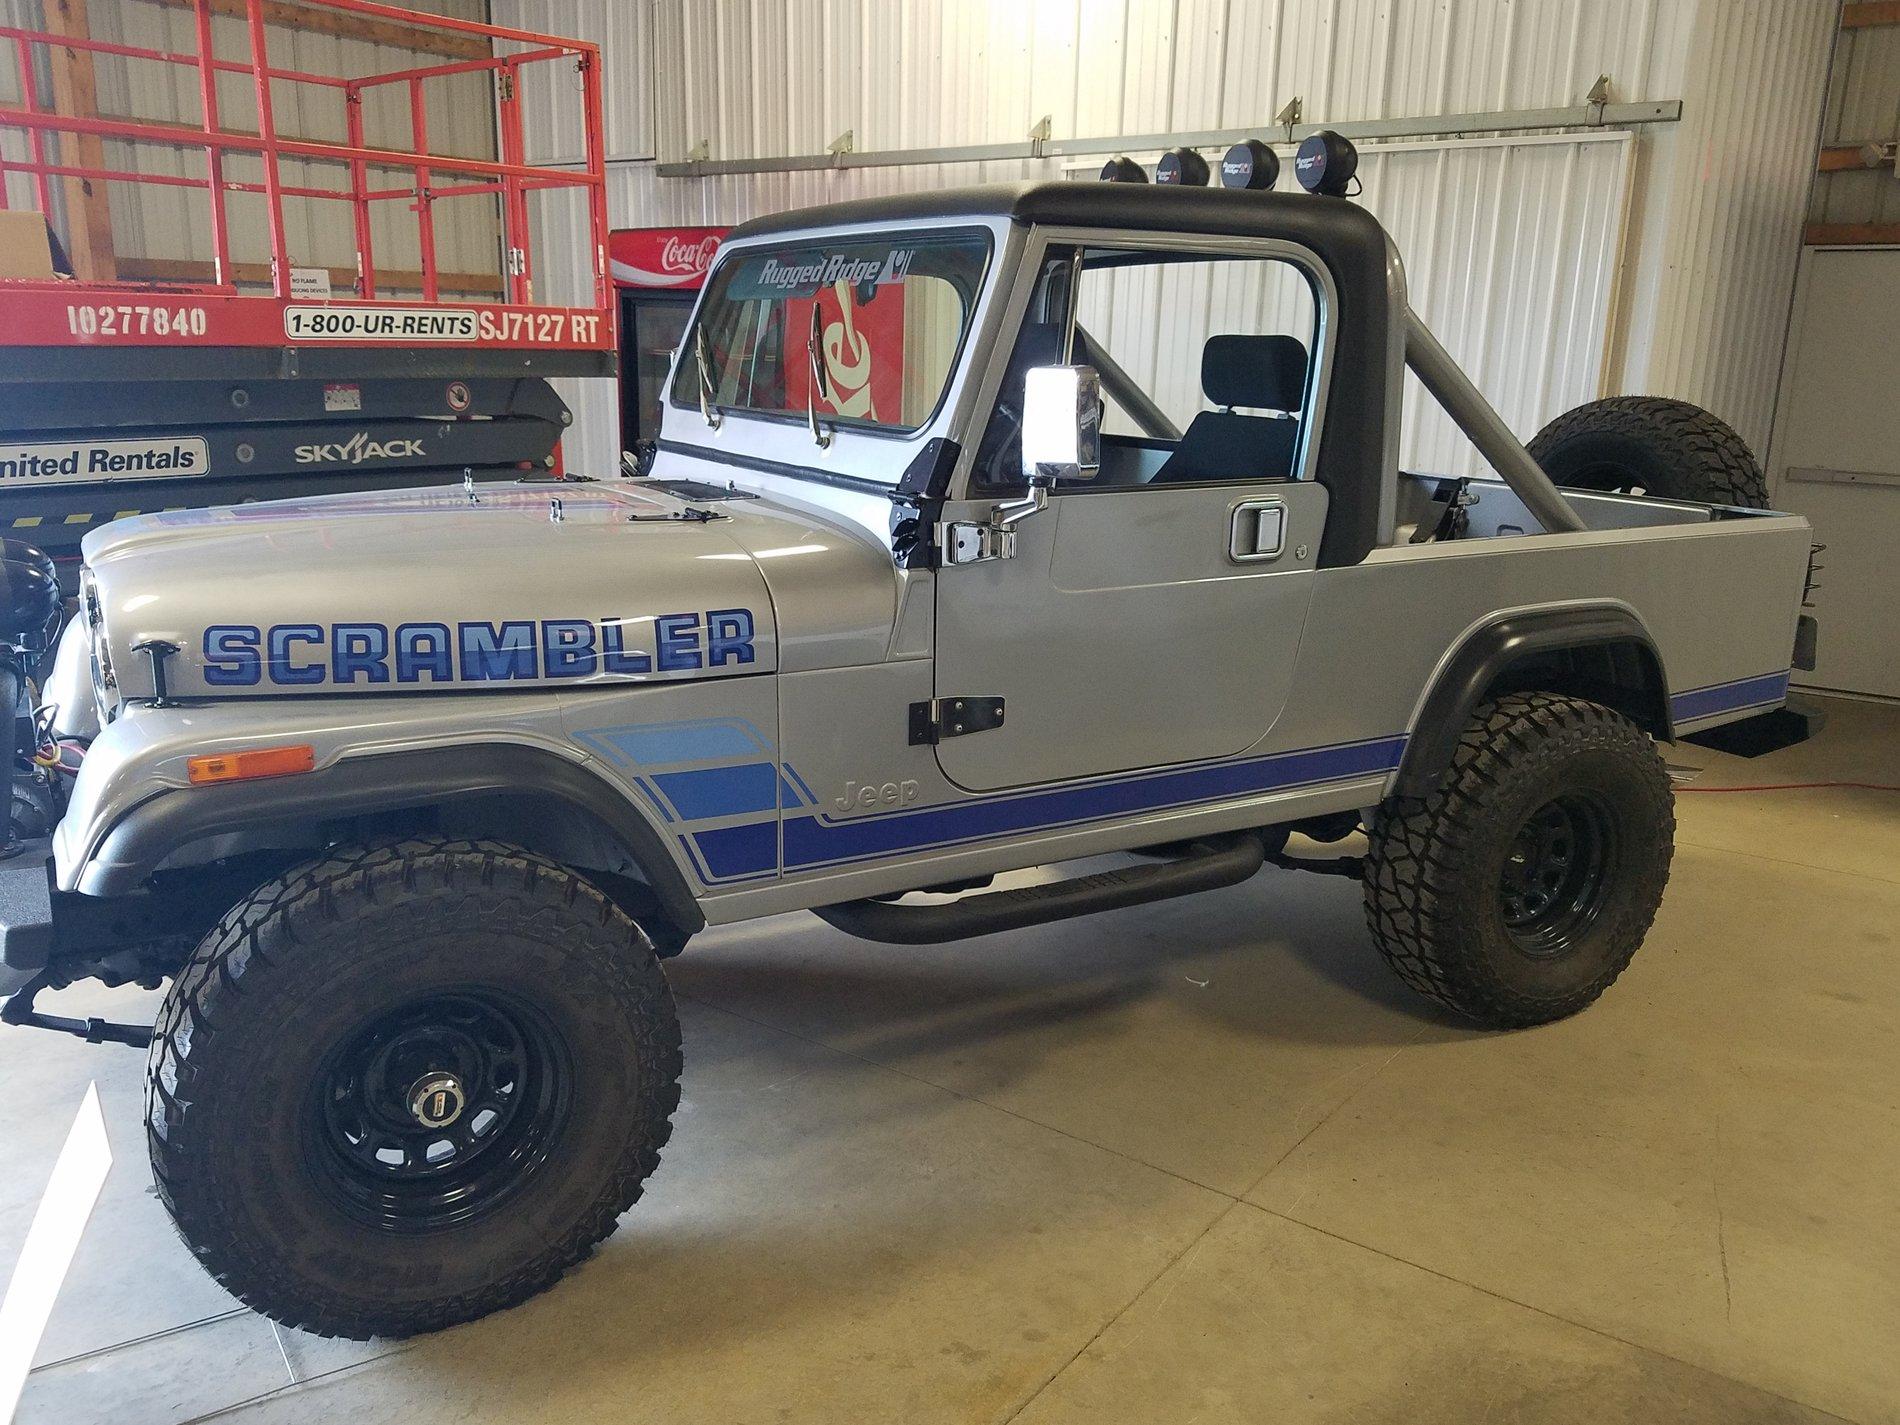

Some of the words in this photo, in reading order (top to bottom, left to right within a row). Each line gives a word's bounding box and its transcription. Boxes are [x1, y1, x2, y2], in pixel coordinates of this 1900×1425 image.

[758, 258, 828, 289] Rugged
[822, 254, 881, 287] Ridge
[292, 314, 472, 335] 1-800-UR-RENTS
[479, 311, 565, 342] SJ7127
[571, 315, 600, 343] RT
[88, 446, 194, 473] Rentals
[294, 431, 426, 464] SKYJACK
[203, 608, 755, 685] SCRAMBLER
[835, 779, 920, 812] Jeep
